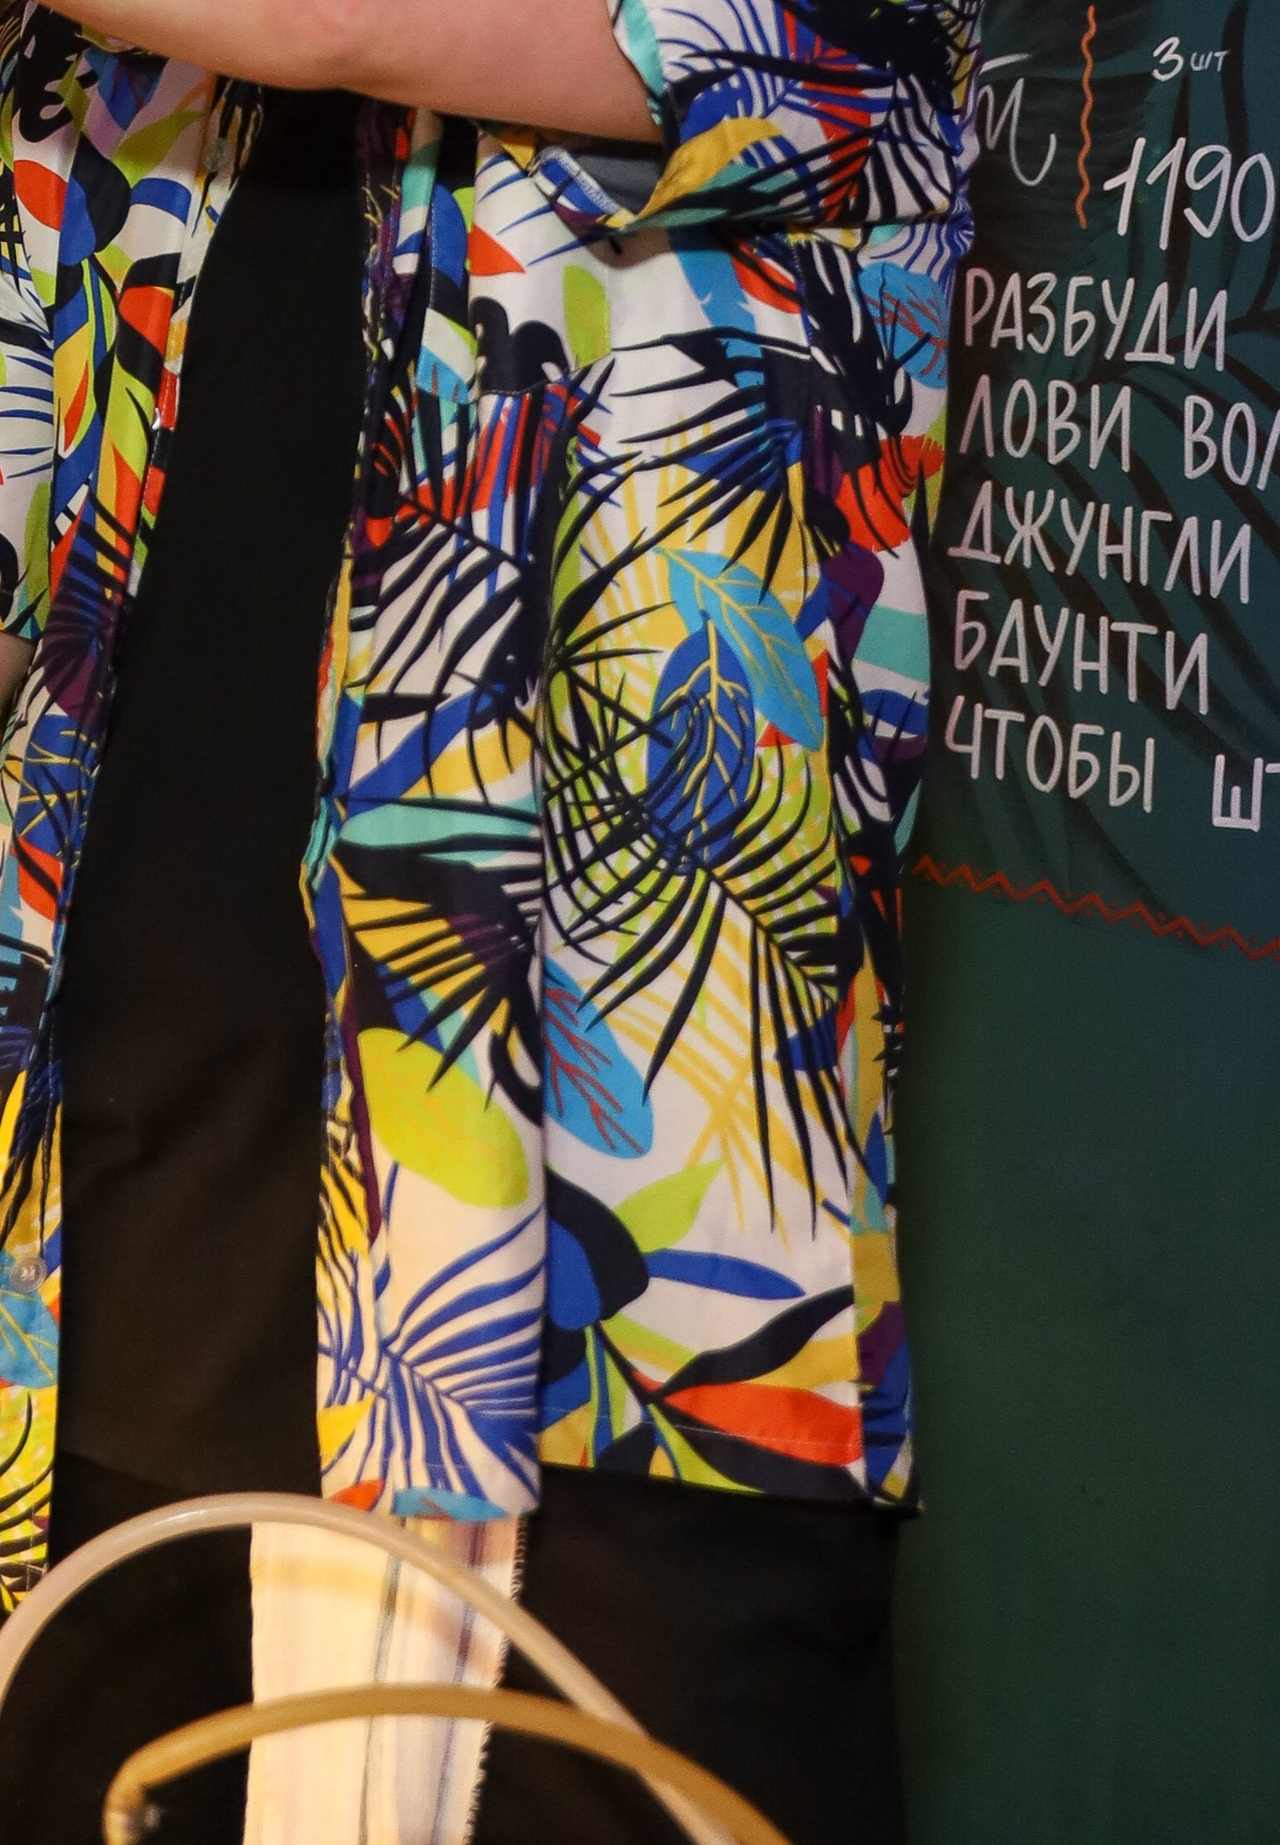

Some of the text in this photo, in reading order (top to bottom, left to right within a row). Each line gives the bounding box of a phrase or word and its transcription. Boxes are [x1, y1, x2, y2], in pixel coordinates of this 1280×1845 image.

[1152, 36, 1184, 82] 3
[1103, 137, 1276, 251] 1190
[965, 267, 1228, 372] РАЗБУДИ
[958, 373, 1132, 473] ЛОВИ
[948, 480, 1251, 605] ДЖУНГЛИ
[954, 589, 1209, 716] БАУНТИ
[945, 695, 1280, 833] ЧТОБЫ Ш
